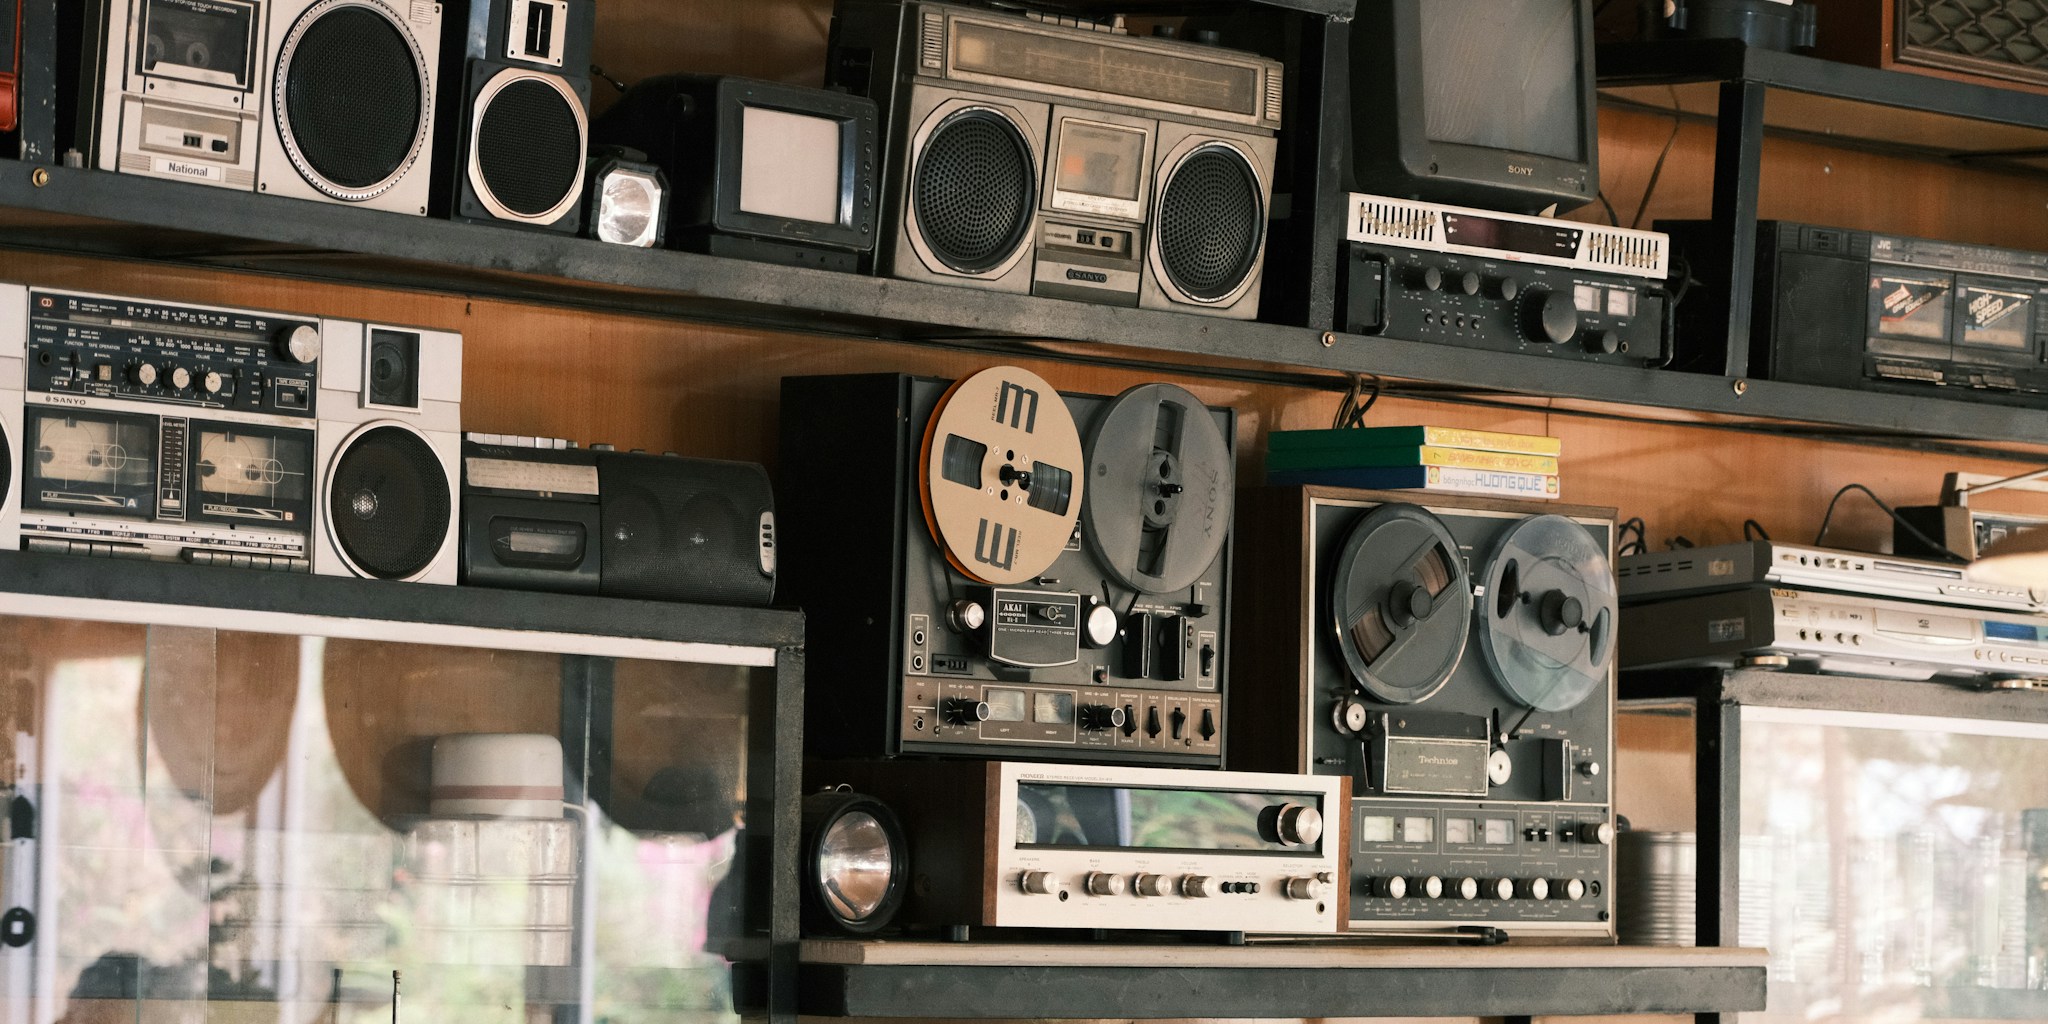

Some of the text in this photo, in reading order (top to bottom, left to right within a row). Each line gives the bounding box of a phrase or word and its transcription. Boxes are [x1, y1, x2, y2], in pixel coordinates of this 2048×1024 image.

[213, 4, 237, 14] RECORDING
[168, 162, 208, 177] National
[1508, 165, 1533, 176] SONY
[1878, 240, 1891, 250] JVC
[1075, 271, 1107, 282] SANYO
[1975, 298, 2004, 324] SPEED
[99, 344, 120, 352] OPERATION
[52, 396, 86, 406] SANYO
[127, 498, 137, 508] A
[1203, 468, 1219, 539] SONY
[1003, 603, 1022, 612] AKAI
[1418, 755, 1458, 766] Technics
